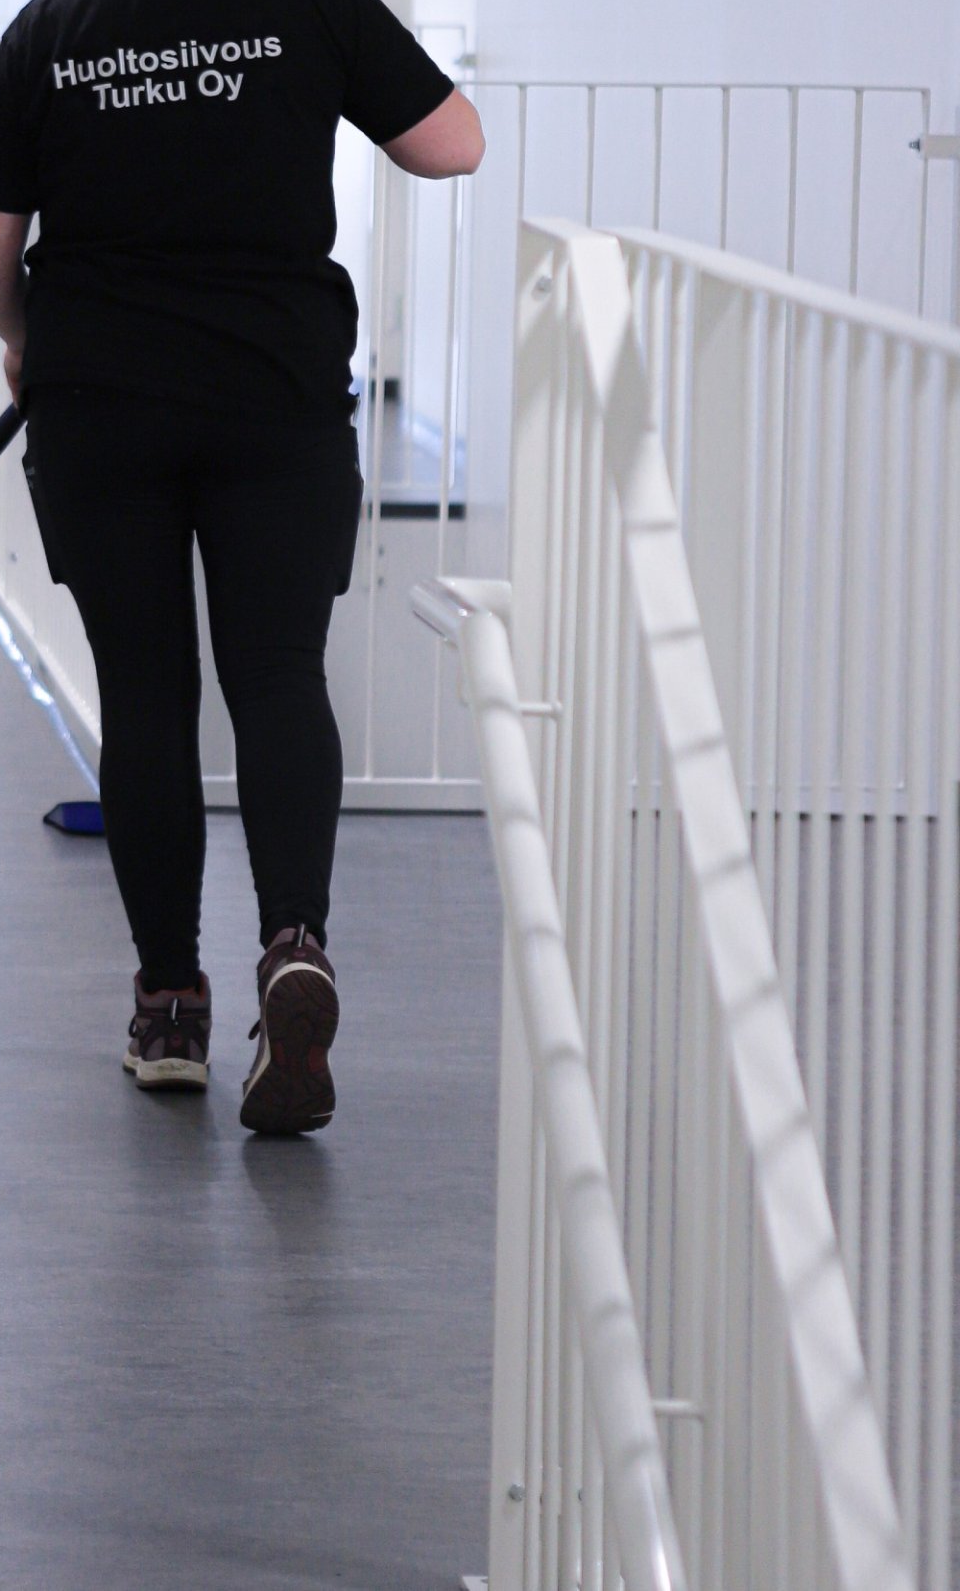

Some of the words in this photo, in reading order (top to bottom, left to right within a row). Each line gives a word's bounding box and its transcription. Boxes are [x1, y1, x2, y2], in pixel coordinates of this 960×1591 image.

[53, 36, 283, 89] Huoltosiivous
[92, 78, 187, 110] Turku
[198, 69, 244, 101] Oy
